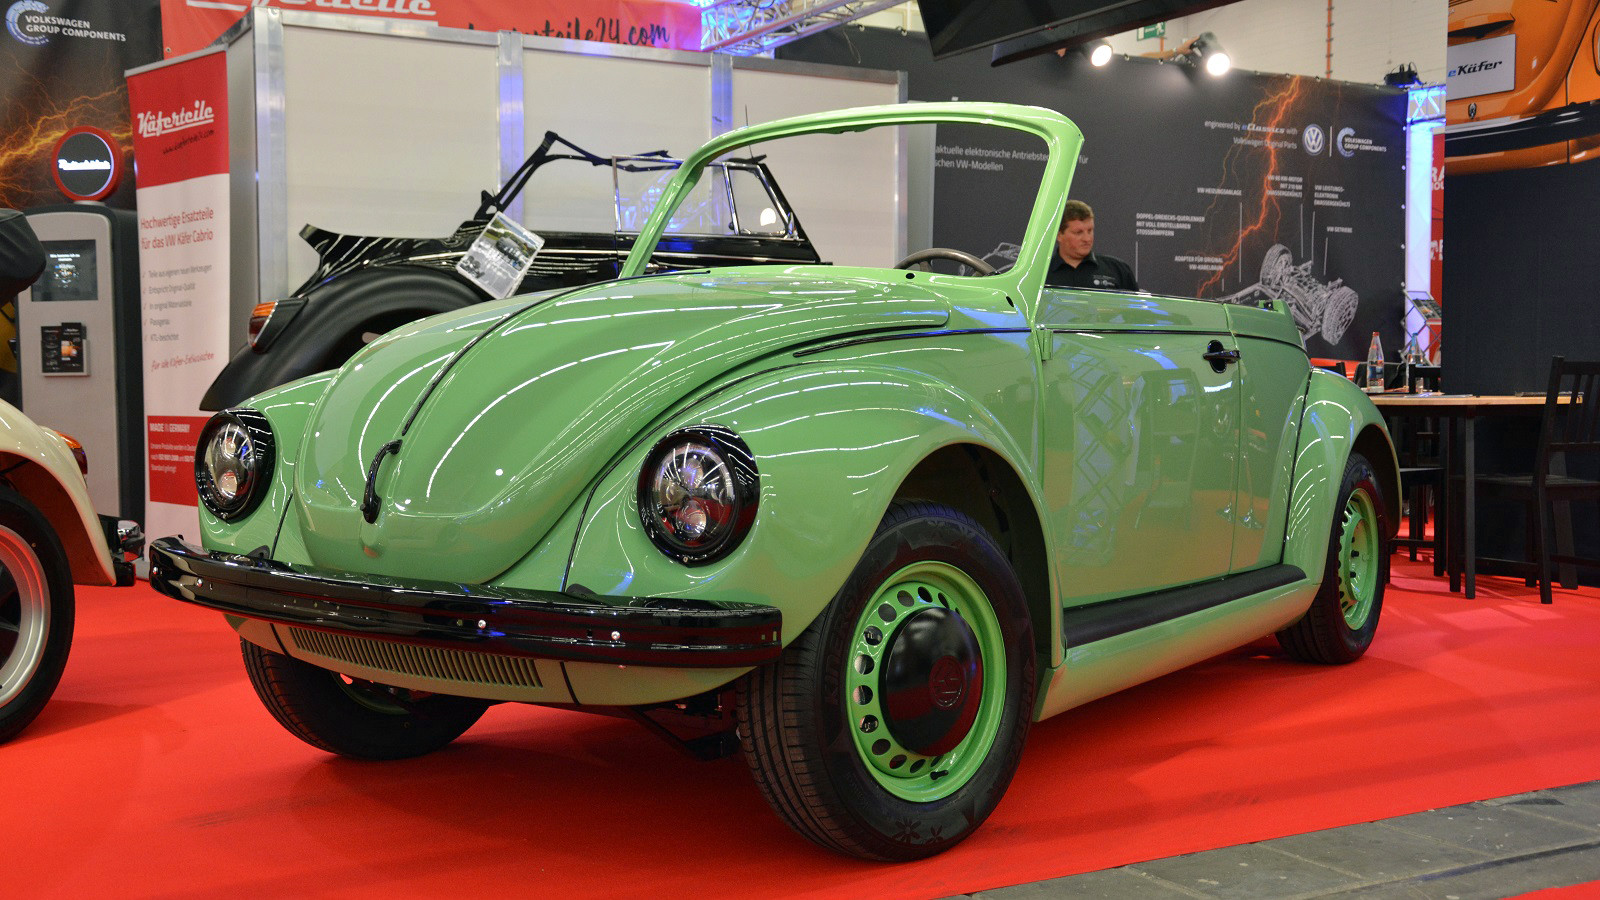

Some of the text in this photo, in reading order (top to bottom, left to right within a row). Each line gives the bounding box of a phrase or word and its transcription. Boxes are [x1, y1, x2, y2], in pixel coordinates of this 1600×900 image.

[25, 15, 91, 29] VOLKSWAGEN
[26, 24, 127, 42] GROUP COMPONENTS
[137, 99, 215, 138] Käferteile
[1204, 120, 1234, 130] engineered
[1234, 122, 1241, 131] by
[1286, 127, 1298, 135] with
[1233, 136, 1263, 148] Volkswagen
[1284, 140, 1298, 150] Parts
[1344, 136, 1373, 145] VOLKSWAGEN
[964, 147, 1011, 159] elektronische
[1359, 144, 1387, 153] COMPONENTS
[955, 160, 1004, 172] VW-Modellen
[141, 206, 214, 229] Hochwertige Ersatzteile
[152, 236, 165, 249] das
[193, 228, 214, 243] Cabrio
